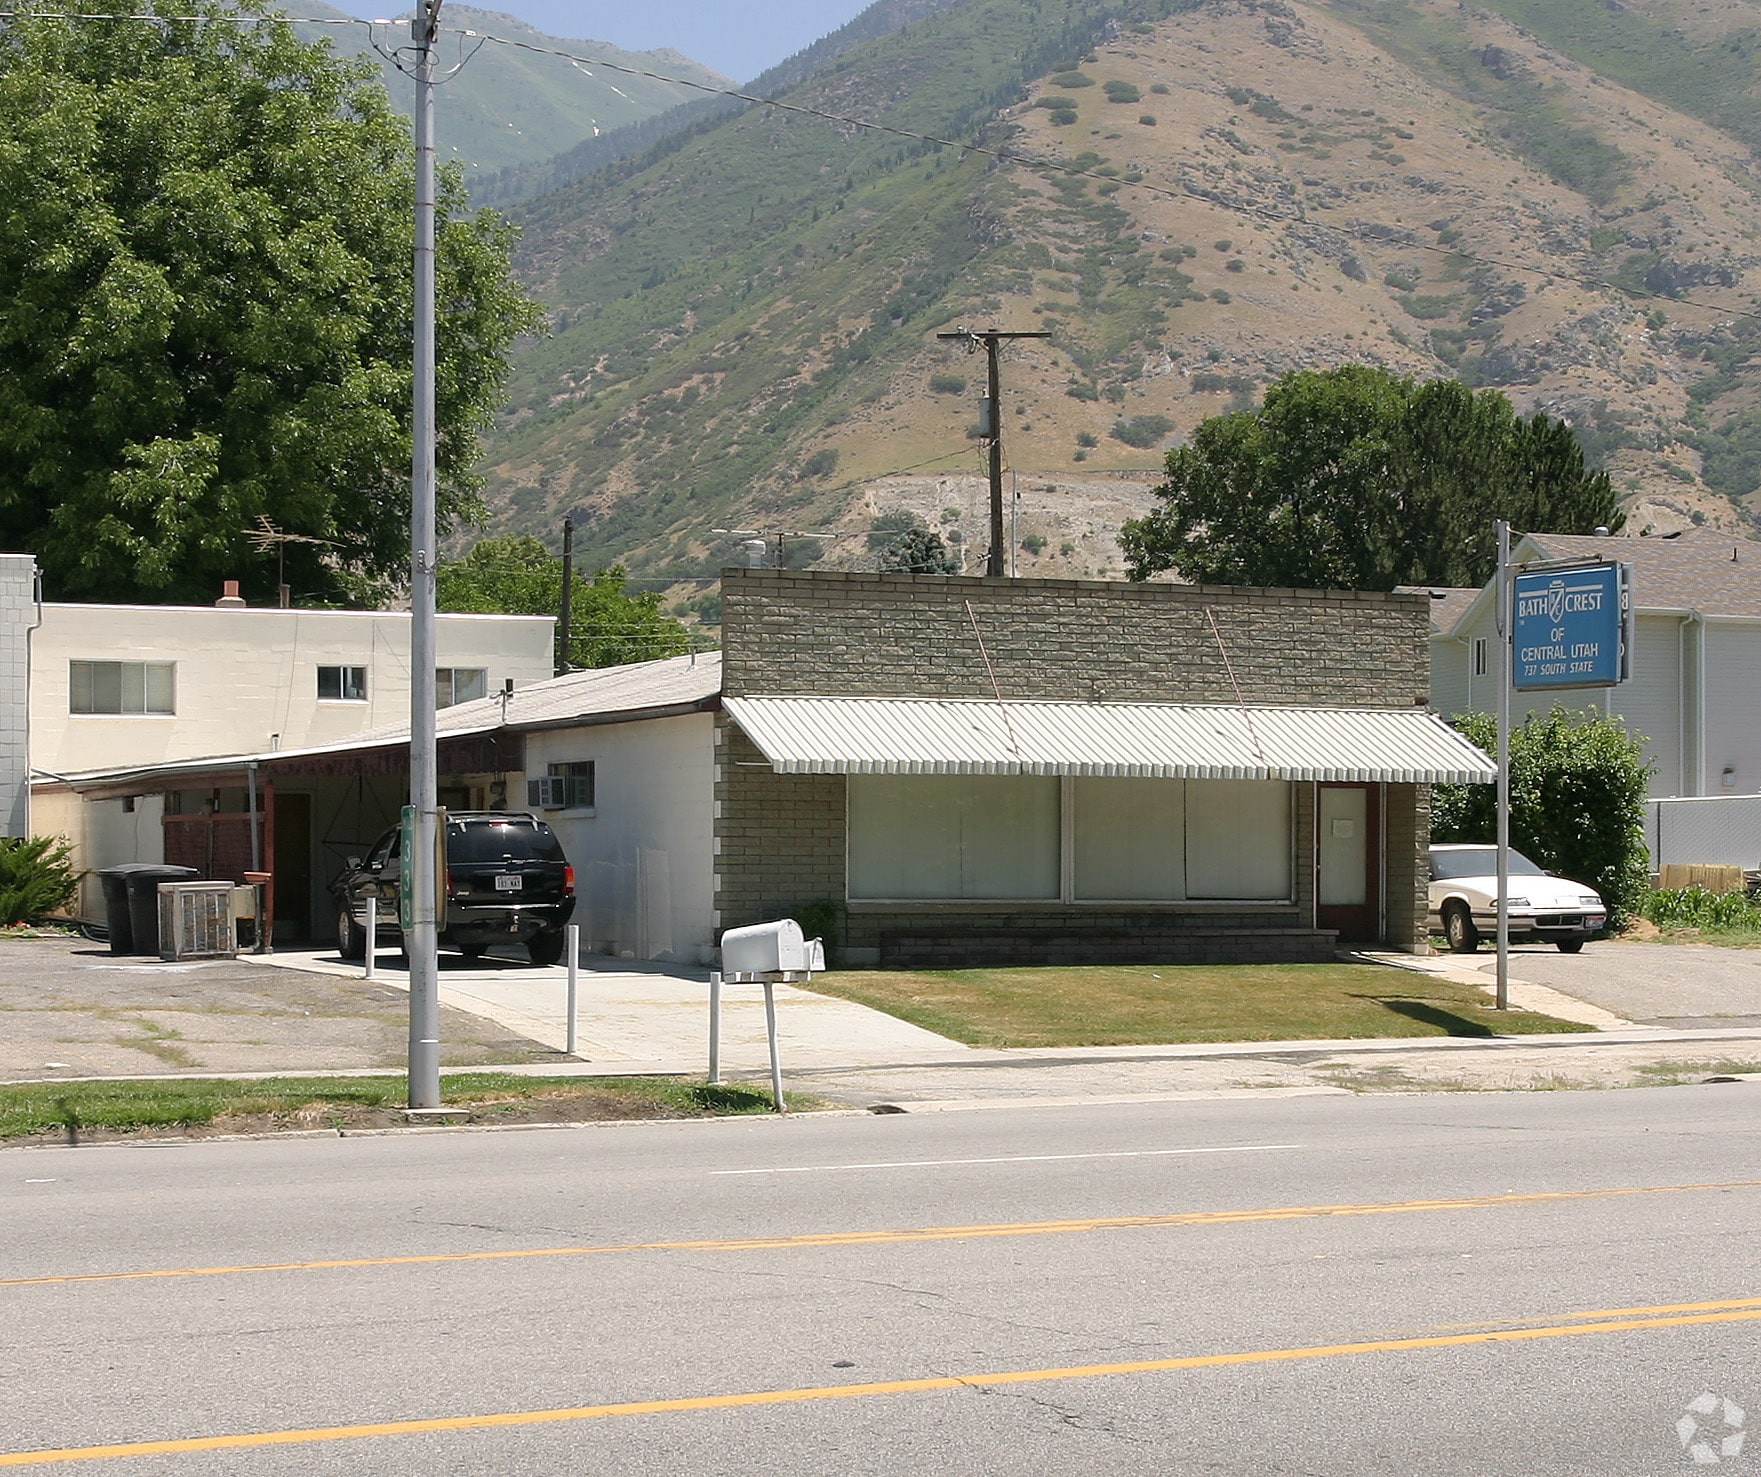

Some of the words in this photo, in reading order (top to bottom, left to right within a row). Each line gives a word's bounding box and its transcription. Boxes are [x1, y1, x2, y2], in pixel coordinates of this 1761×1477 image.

[1519, 597, 1548, 617] BATH
[1565, 592, 1603, 612] CREST
[1550, 627, 1565, 642] OF
[1521, 645, 1567, 662] CENTRAL
[1571, 642, 1598, 658] UTAH
[1524, 664, 1537, 676] 737
[1540, 663, 1566, 675] SOUTH
[1570, 661, 1593, 673] STATE
